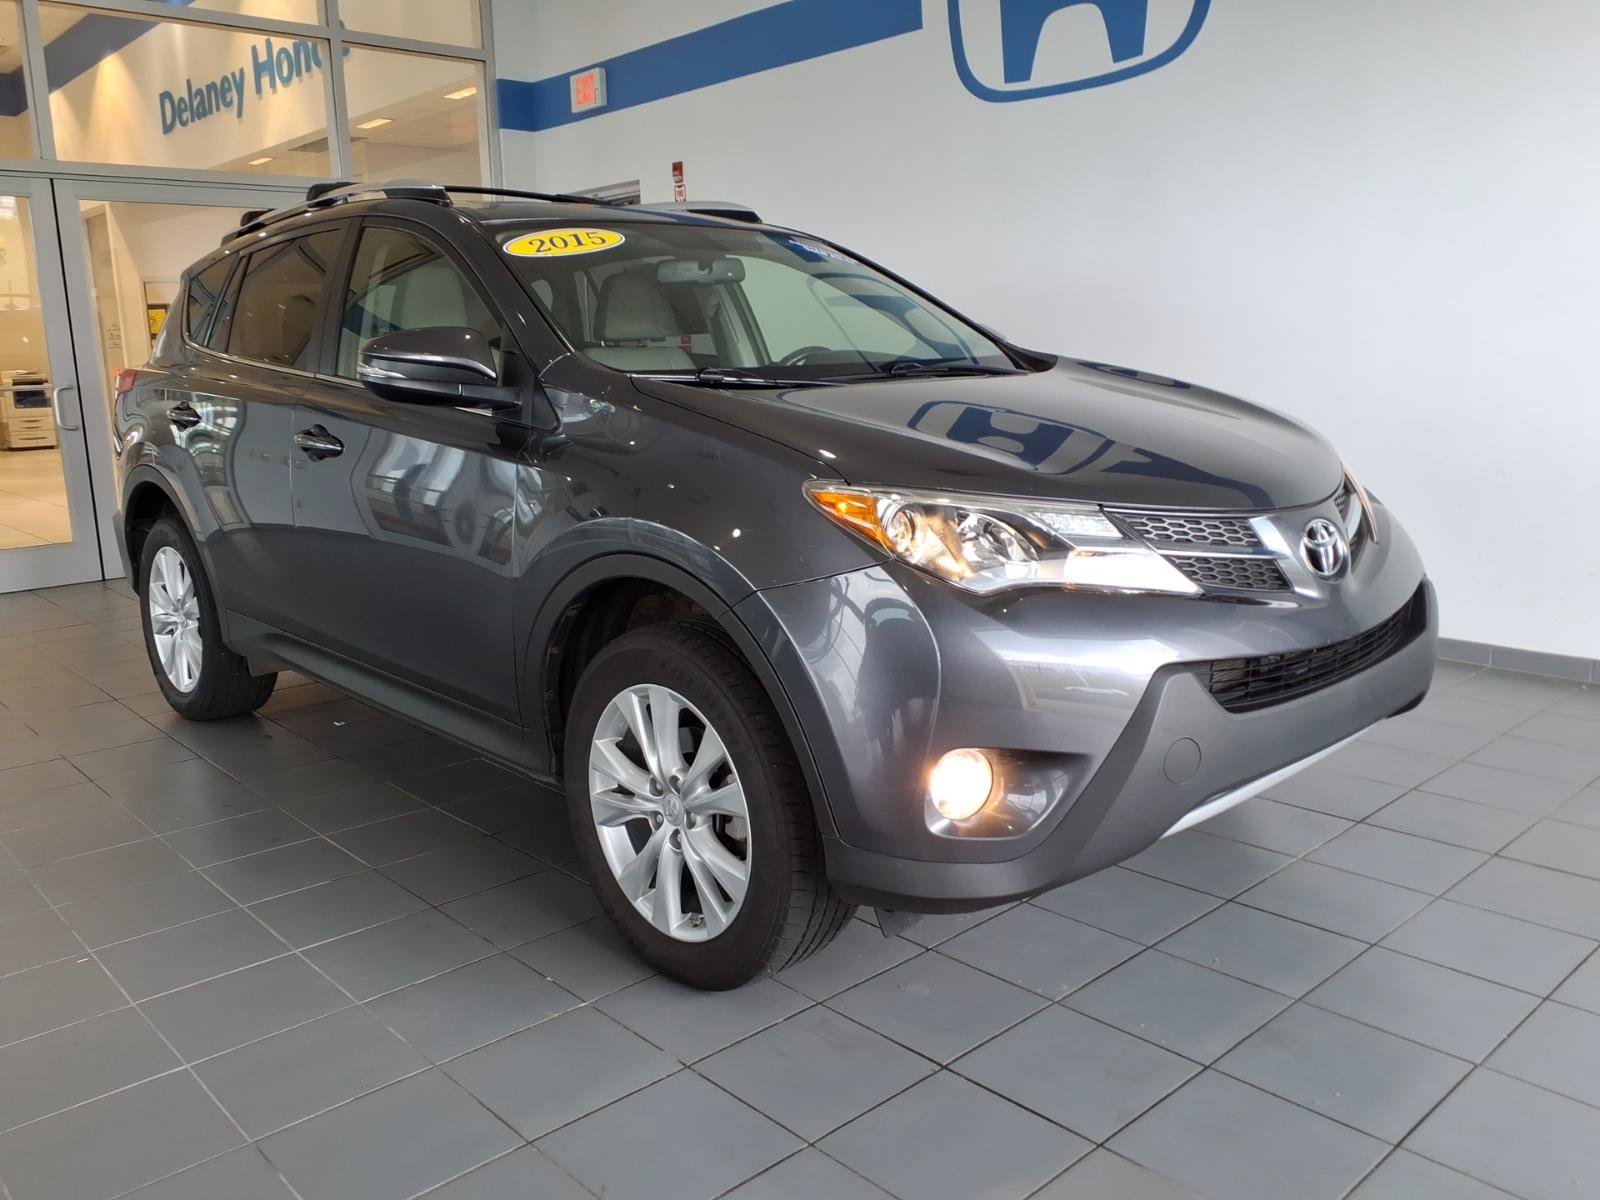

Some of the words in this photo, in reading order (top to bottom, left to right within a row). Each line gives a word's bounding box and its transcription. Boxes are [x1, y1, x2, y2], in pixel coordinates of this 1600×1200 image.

[159, 67, 245, 135] Delaney
[251, 20, 350, 95] Hon
[528, 231, 606, 253] 2015
